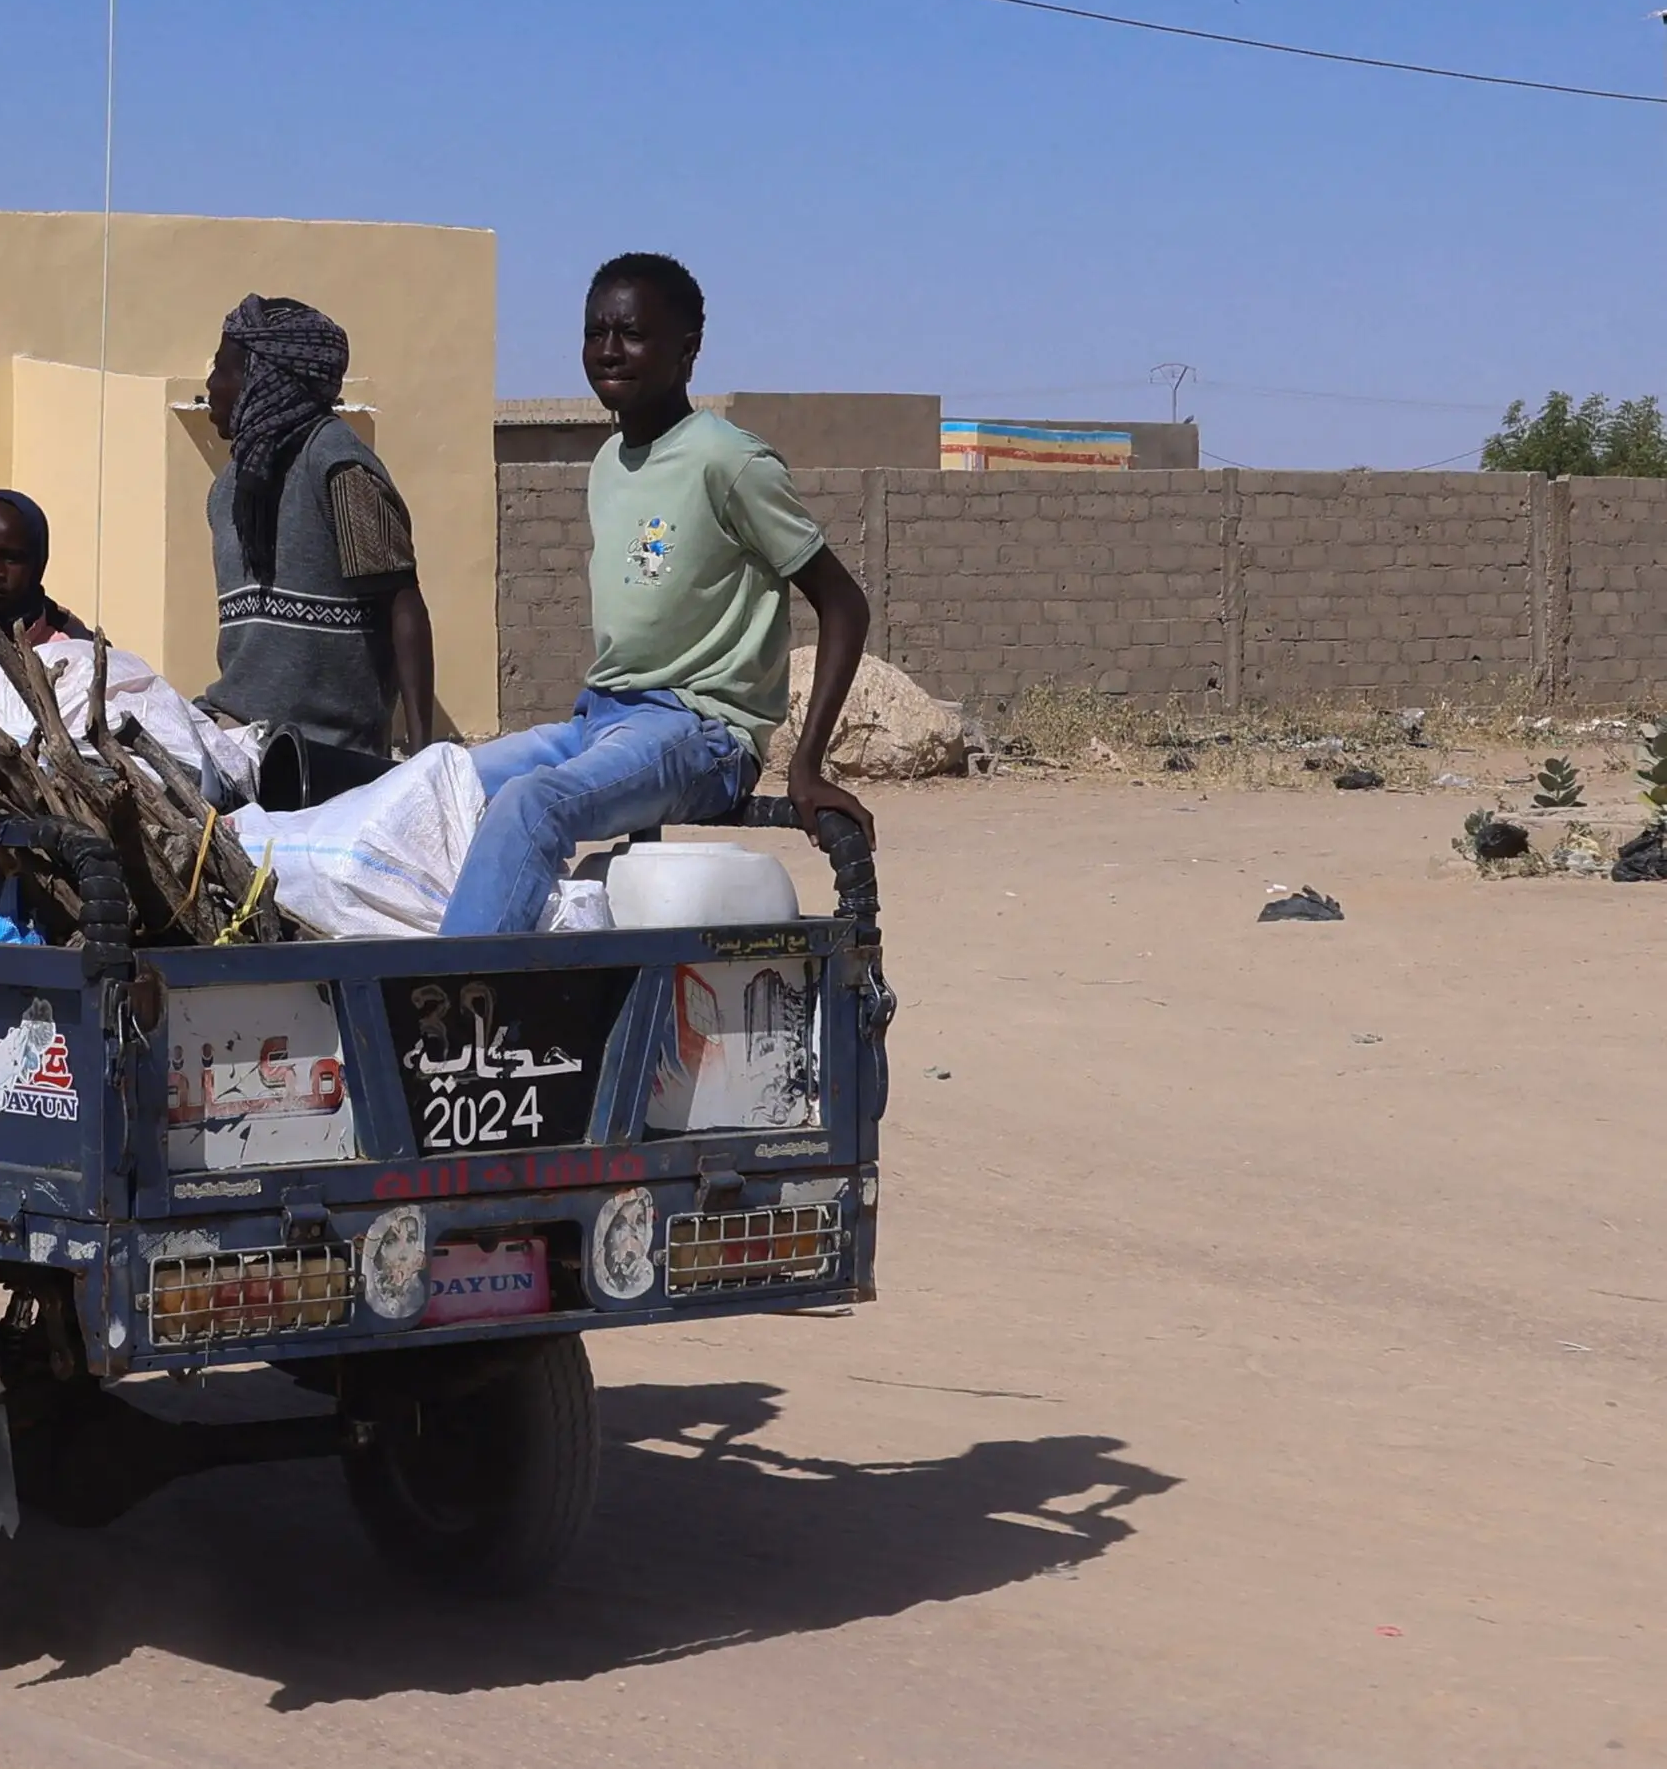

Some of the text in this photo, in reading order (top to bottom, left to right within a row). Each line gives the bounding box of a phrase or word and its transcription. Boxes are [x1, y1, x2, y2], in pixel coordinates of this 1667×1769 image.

[423, 1085, 544, 1148] 2024
[372, 1159, 469, 1201] الله
[430, 1271, 534, 1297] DAYUN
